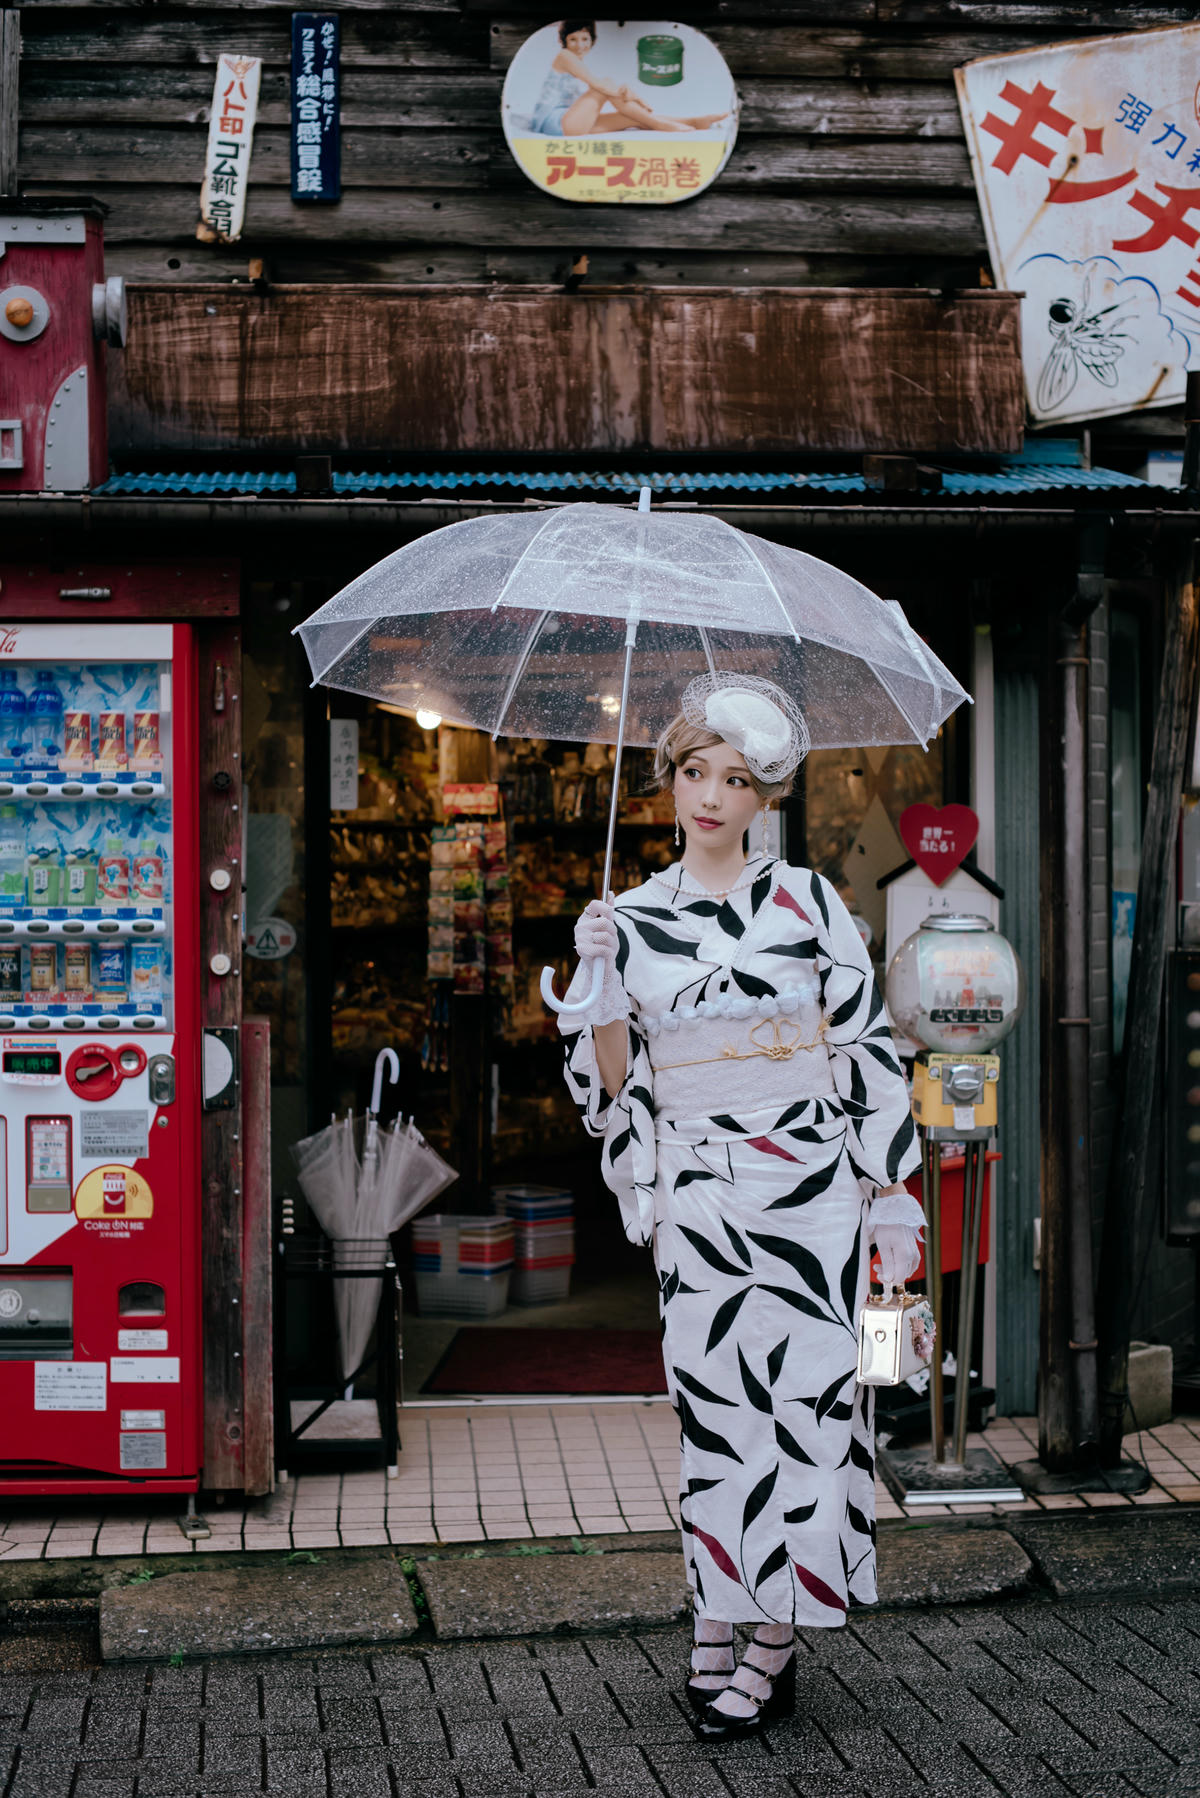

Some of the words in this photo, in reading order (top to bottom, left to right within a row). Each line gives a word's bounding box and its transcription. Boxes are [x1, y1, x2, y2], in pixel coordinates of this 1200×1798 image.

[546, 156, 700, 188] アース渦巻
[923, 827, 953, 839] 世界一
[920, 840, 955, 853] 当たる！
[84, 1221, 111, 1231] Coke
